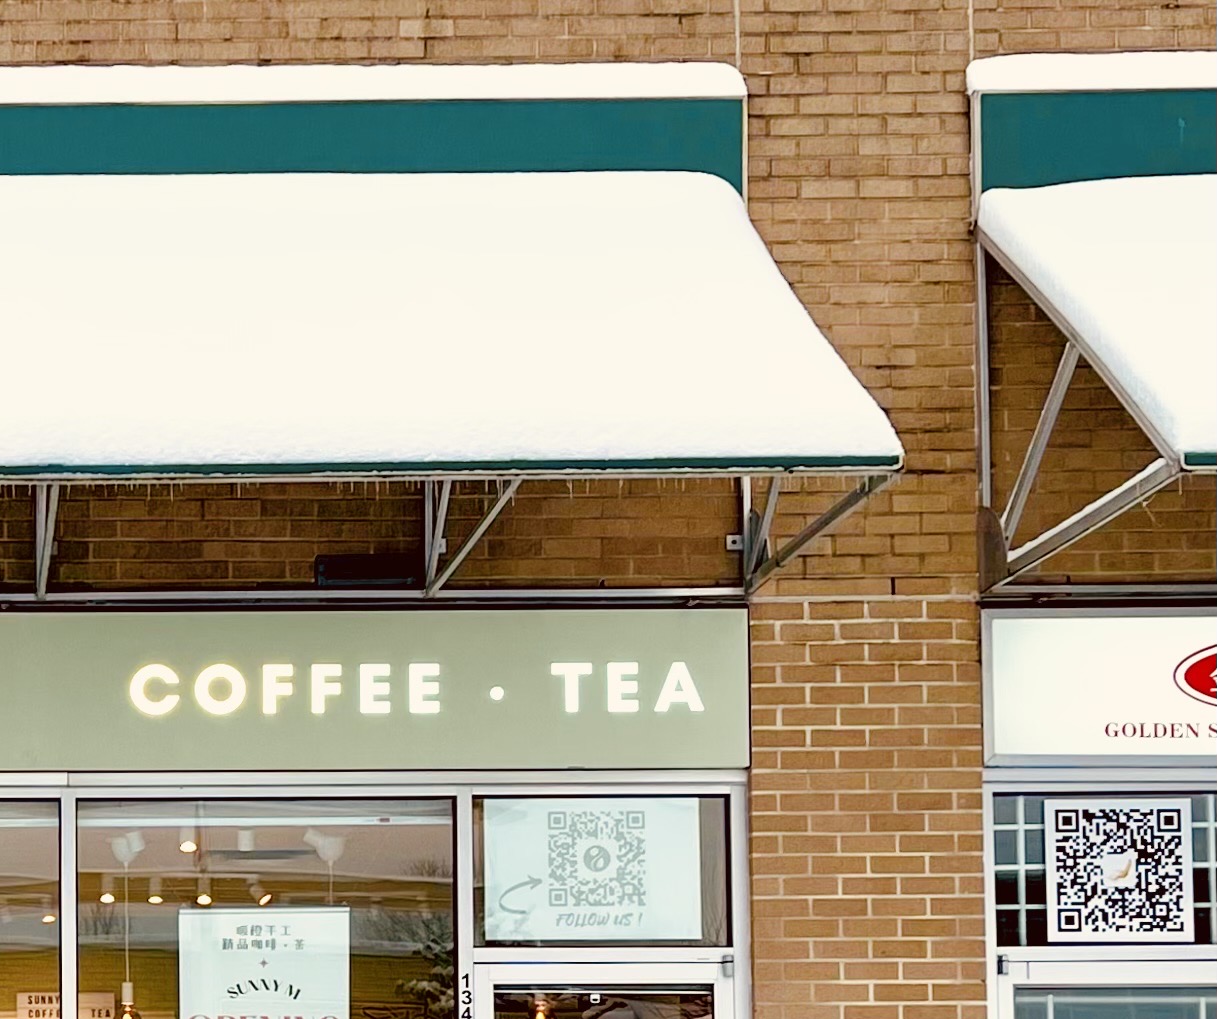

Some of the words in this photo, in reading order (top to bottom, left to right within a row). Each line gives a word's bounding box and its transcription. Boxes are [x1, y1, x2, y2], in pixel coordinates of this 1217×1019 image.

[129, 662, 441, 716] COFFEE
[550, 661, 705, 713] TEA
[1104, 722, 1200, 739] GOLDEN
[555, 912, 611, 928] FOLLOW
[226, 978, 283, 999] SUNNY
[285, 984, 302, 1000] M
[27, 995, 60, 1005] SUNNY
[91, 1008, 112, 1018] TEA
